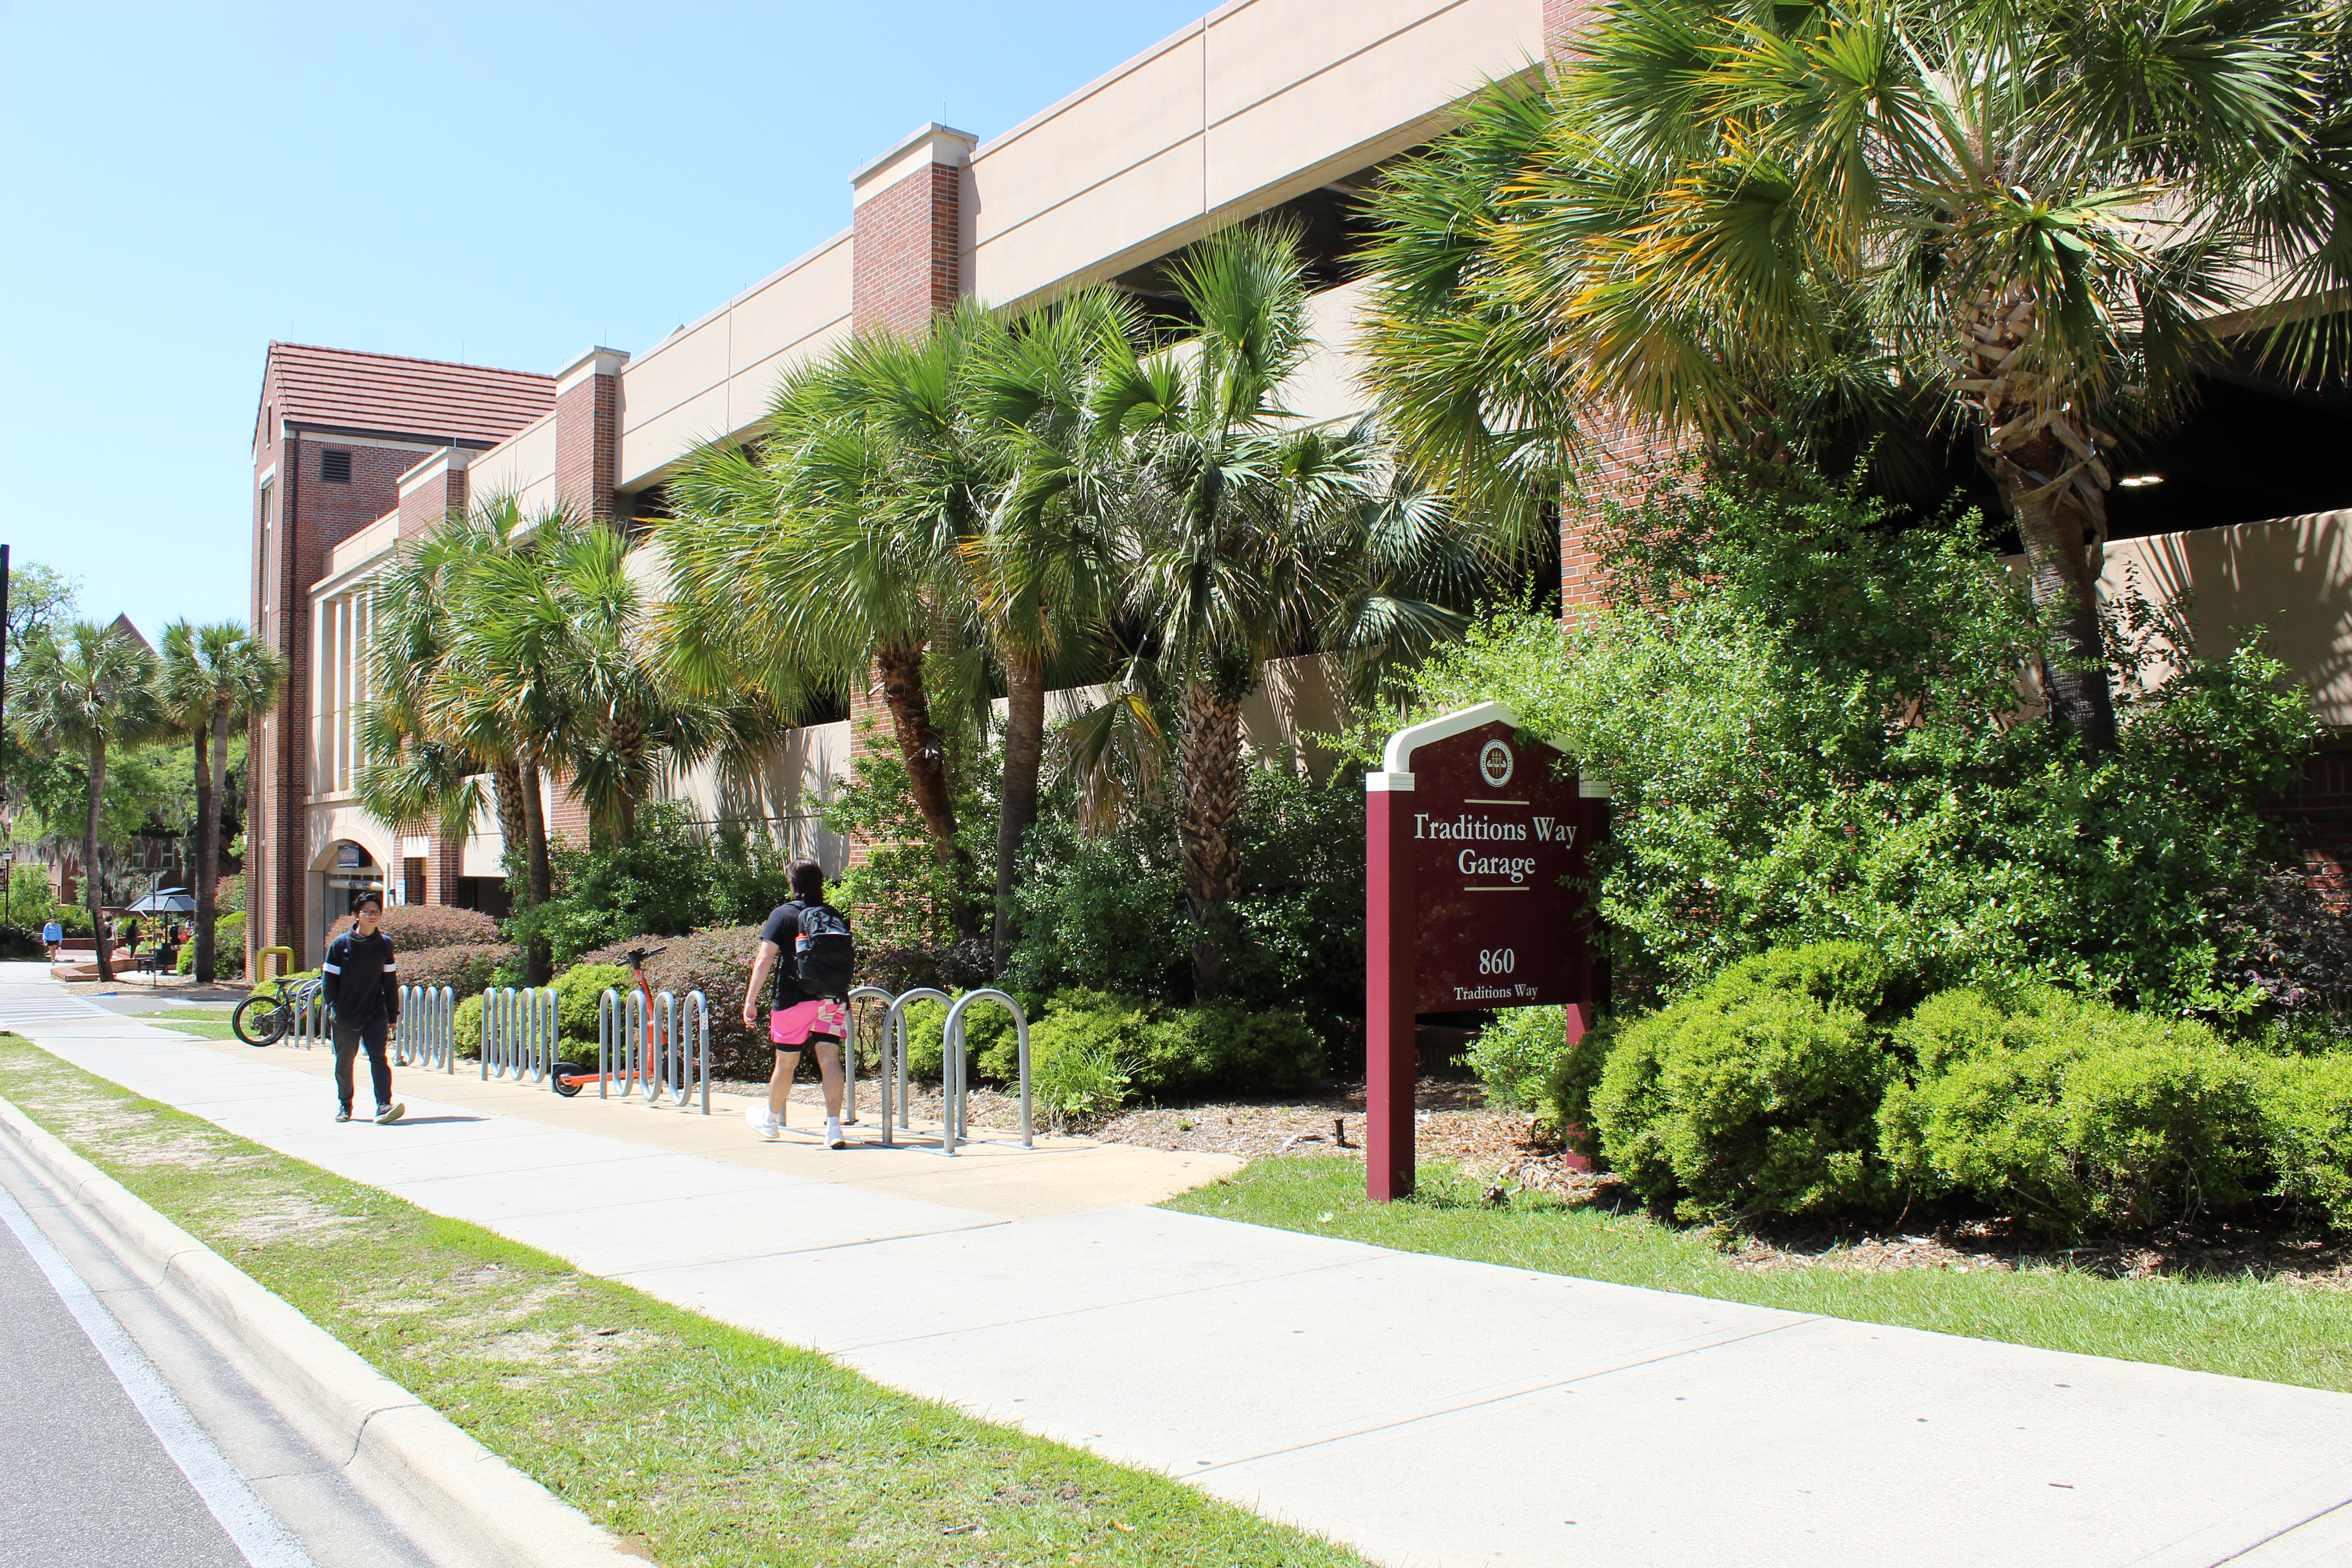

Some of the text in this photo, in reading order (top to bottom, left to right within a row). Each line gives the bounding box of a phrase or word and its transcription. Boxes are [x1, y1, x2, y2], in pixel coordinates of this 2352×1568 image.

[1500, 745, 1511, 775] UNIVERSITY
[1414, 813, 1577, 849] Traditions Way
[1459, 849, 1535, 882] Garage
[1480, 949, 1514, 974] 860
[1454, 984, 1538, 1000] Traditions Way
